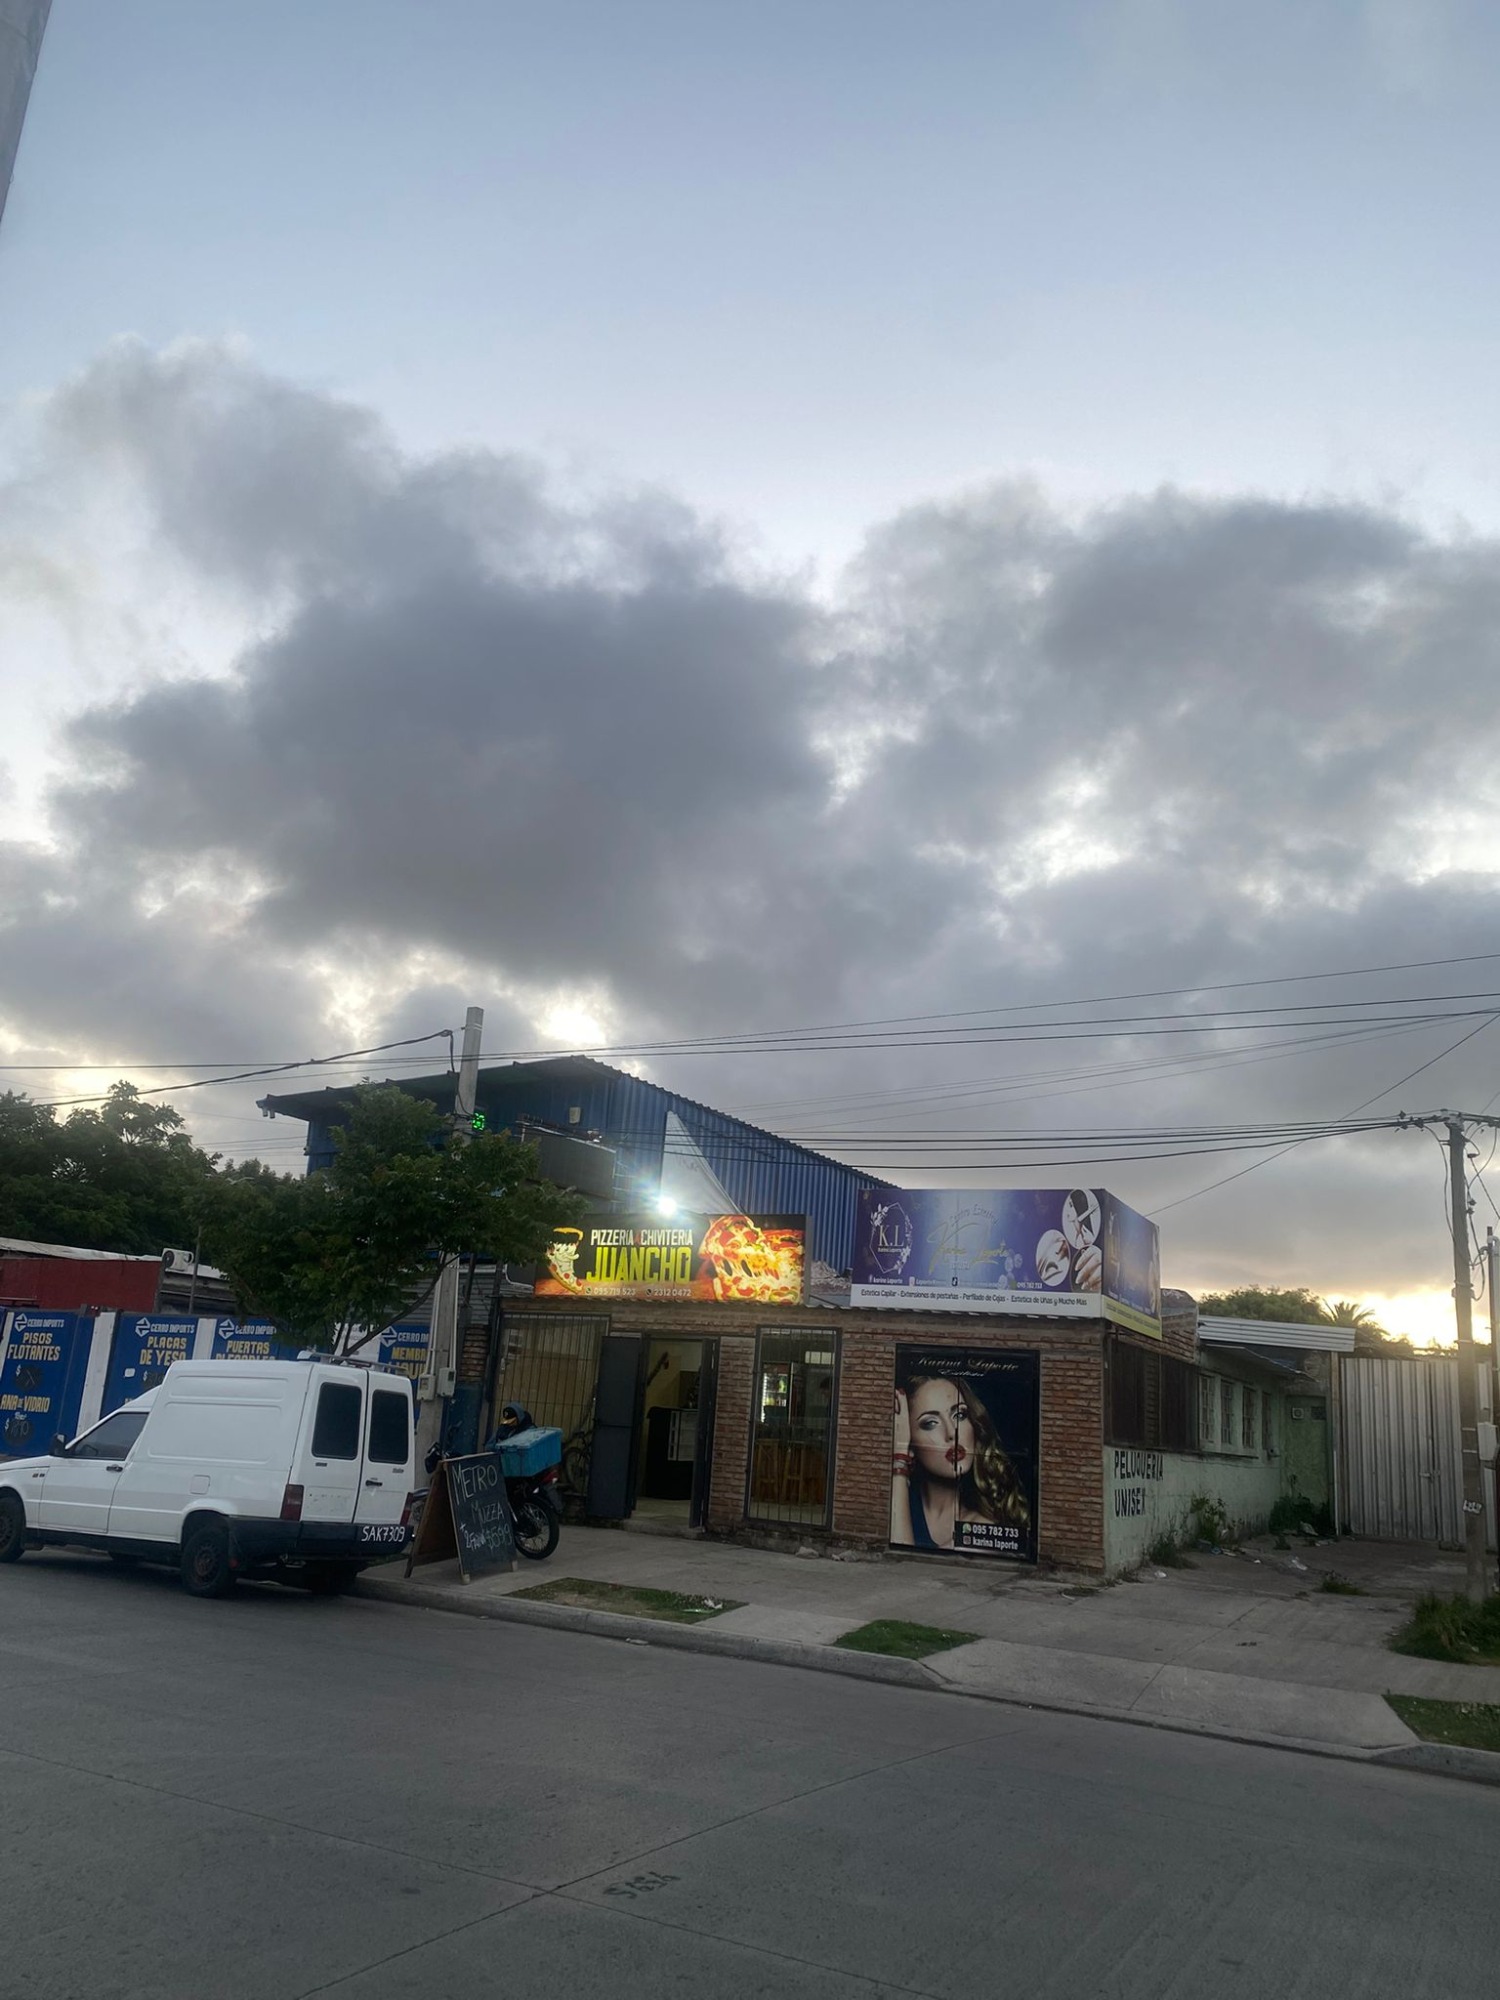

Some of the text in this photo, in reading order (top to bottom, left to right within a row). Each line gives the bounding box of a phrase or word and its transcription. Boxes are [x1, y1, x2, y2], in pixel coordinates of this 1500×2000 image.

[586, 1246, 692, 1285] JUANCHO
[150, 1323, 195, 1334] CERRO IMPORTS
[22, 1332, 53, 1345] PISOS
[147, 1336, 187, 1350] PLACAS
[397, 1331, 421, 1343] CERRO
[7, 1344, 61, 1361] FLOTANTES
[226, 1340, 270, 1355] PUERTAS
[391, 1347, 427, 1361] MEMBR
[139, 1348, 153, 1366] DE
[24, 1395, 51, 1413] VIDRIO
[1114, 1450, 1164, 1482] PELUQUERIA
[451, 1462, 498, 1506] METRO
[1114, 1487, 1146, 1518] UNISEX
[361, 1526, 405, 1542] SAK7309
[972, 1524, 1019, 1539] 095 782 733
[972, 1536, 1019, 1551] karina laporte
